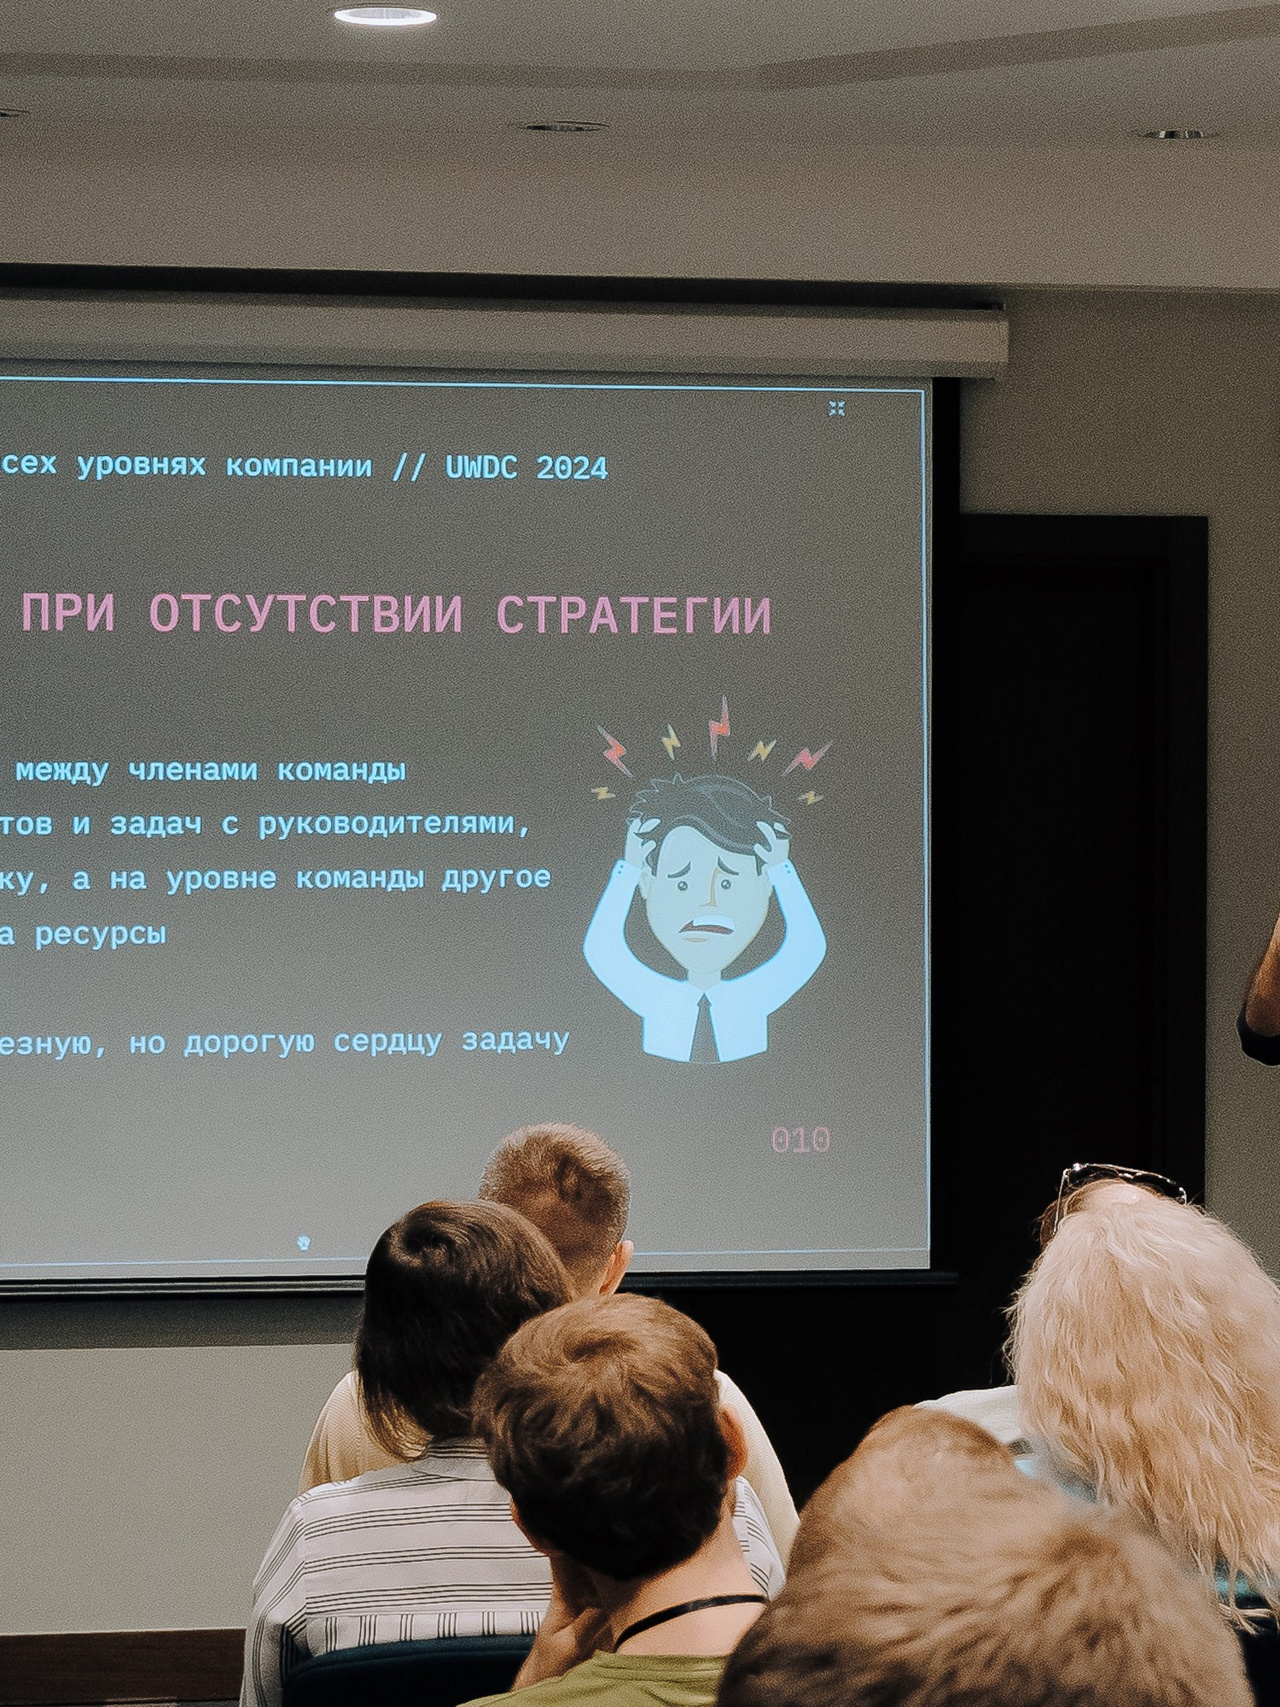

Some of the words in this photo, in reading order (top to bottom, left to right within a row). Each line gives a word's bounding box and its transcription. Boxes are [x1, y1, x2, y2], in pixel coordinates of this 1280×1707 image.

[1, 454, 57, 475] сех
[77, 455, 206, 481] уровнях
[226, 457, 372, 478] компании
[445, 454, 518, 479] UWDC
[536, 455, 609, 480] 2024
[22, 592, 115, 632] ПРИ
[149, 592, 462, 634] ОТСУТСТВИИ
[497, 594, 772, 634] СТРАТЕГИИ
[15, 760, 109, 786] между
[128, 761, 258, 782] членами
[277, 760, 406, 785] команды
[0, 816, 53, 836] тов
[72, 815, 91, 835] и
[110, 814, 202, 837] задач
[221, 815, 239, 836] с
[258, 813, 530, 840] руководителями,
[0, 871, 48, 896] ку,
[72, 870, 91, 891] а
[109, 869, 147, 891] на
[166, 868, 278, 896] уровне
[296, 867, 425, 892] команды
[441, 867, 551, 895] другое
[34, 924, 167, 951] ресурсы
[0, 1035, 105, 1061] езную,
[129, 1034, 167, 1055] но
[183, 1032, 315, 1059] дорогую
[333, 1031, 442, 1057] сердцу
[463, 1030, 570, 1055] задачу
[771, 1125, 831, 1153] 010
